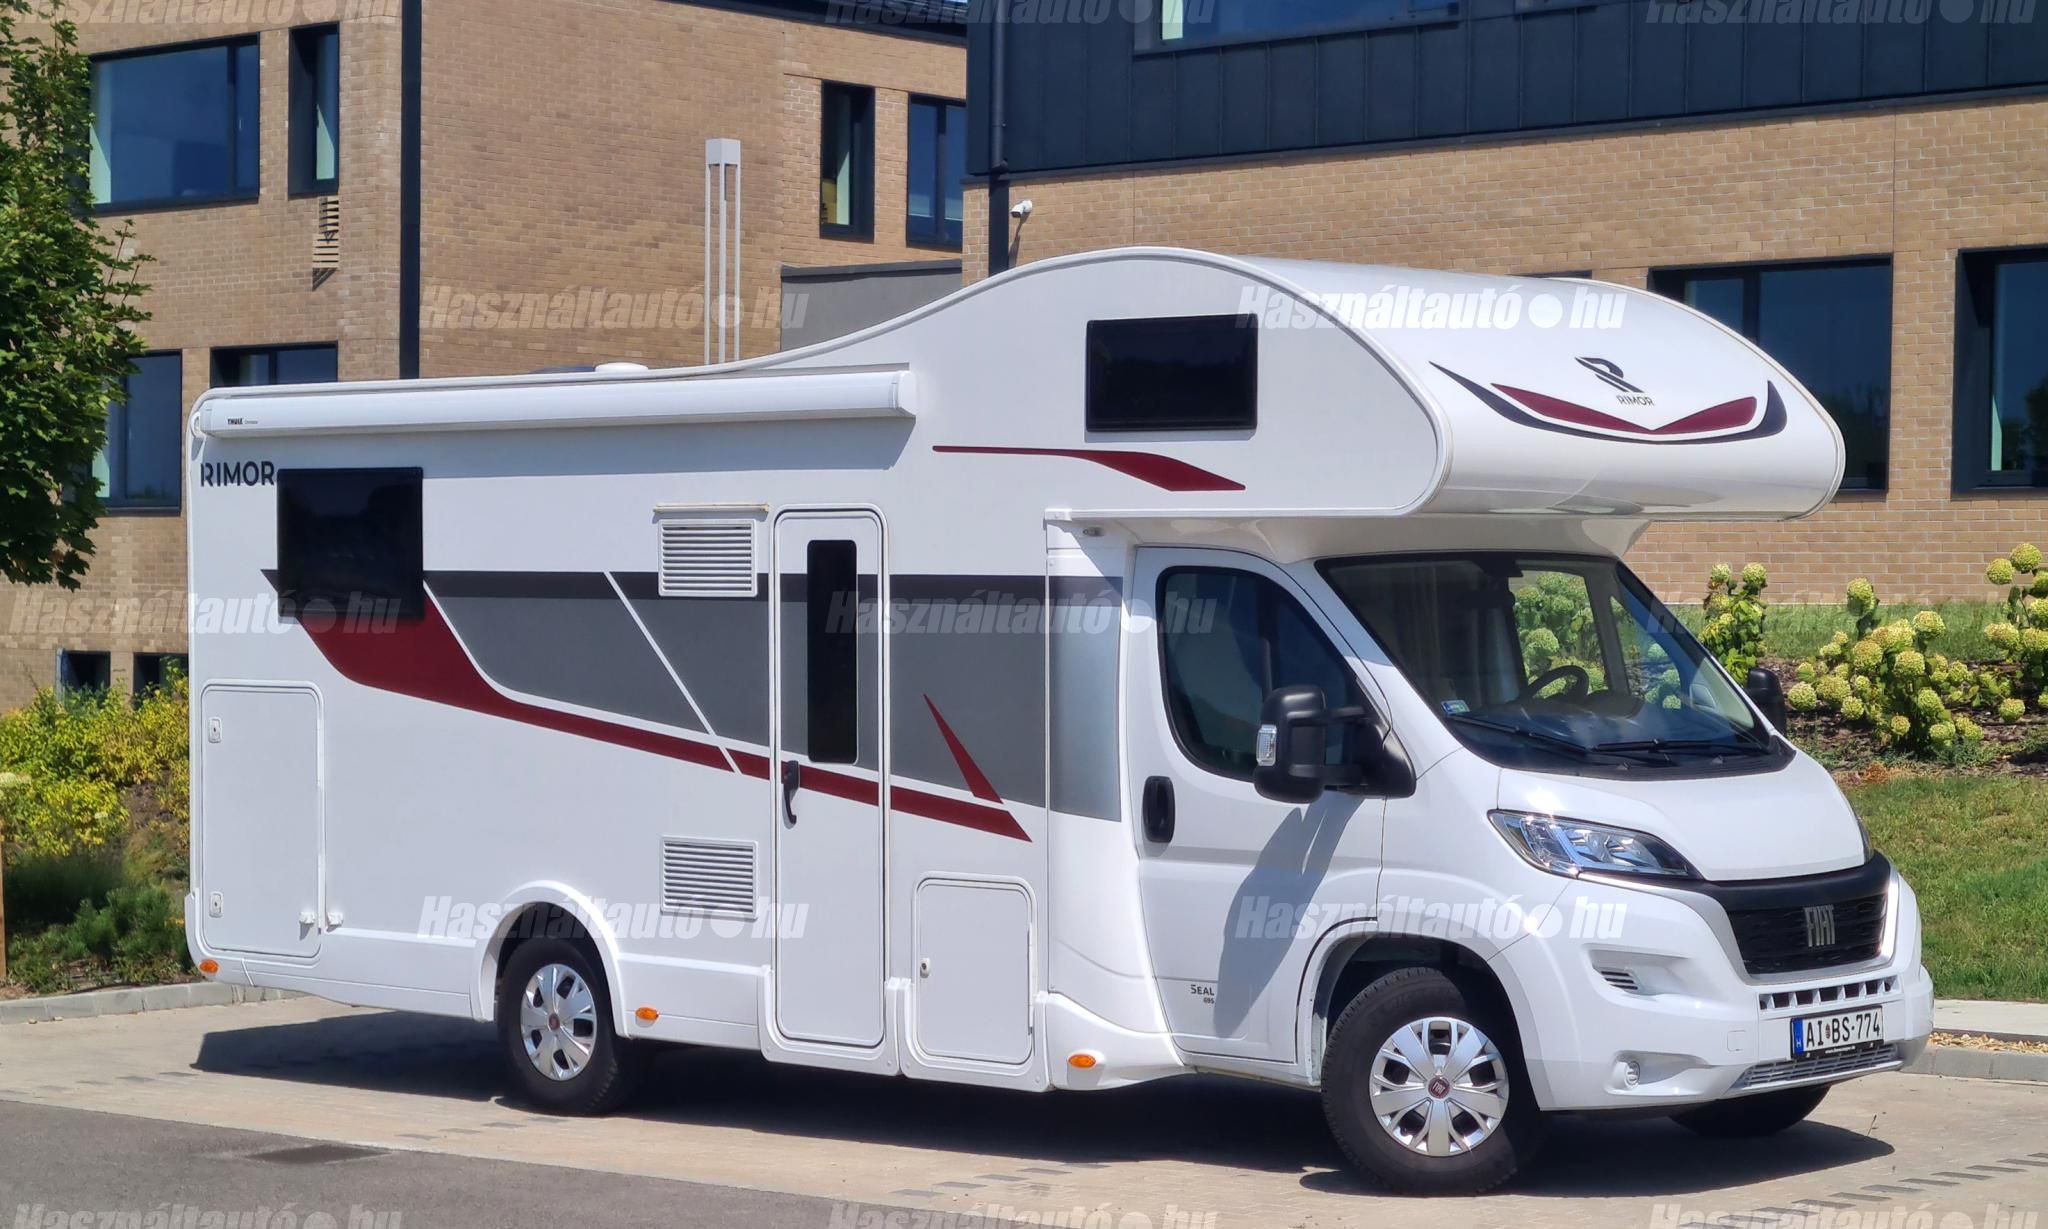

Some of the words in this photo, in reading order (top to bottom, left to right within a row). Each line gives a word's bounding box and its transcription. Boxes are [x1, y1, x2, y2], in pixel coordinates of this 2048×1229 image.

[1616, 395, 1655, 406] RIMOR
[200, 460, 275, 487] RIMOR
[1803, 904, 1836, 947] FIAT
[1190, 984, 1215, 996] SEAL
